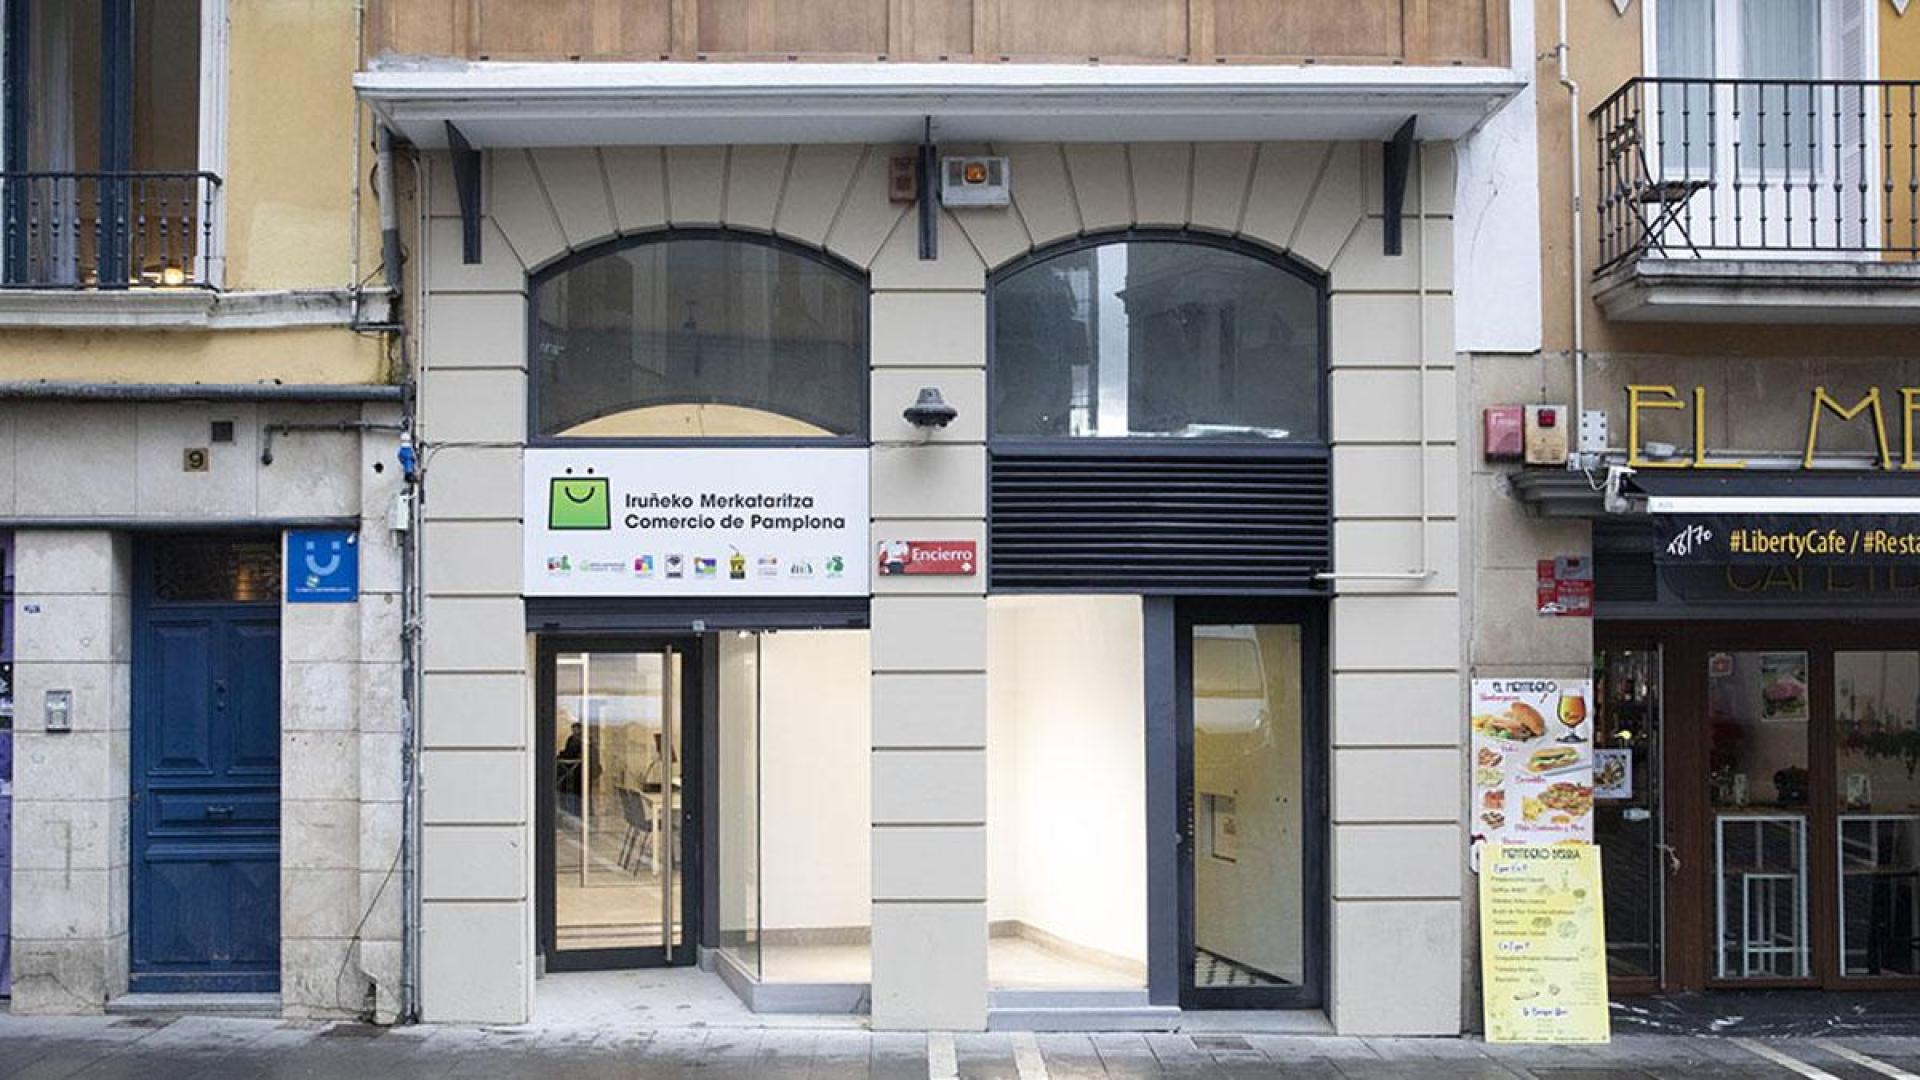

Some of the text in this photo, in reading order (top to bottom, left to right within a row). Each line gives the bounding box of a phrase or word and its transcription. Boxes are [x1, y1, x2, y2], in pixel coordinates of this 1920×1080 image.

[1627, 384, 1747, 468] EL
[189, 450, 204, 469] 9
[625, 492, 814, 508] Iruñeko Merkataritza
[624, 513, 845, 532] Comercio de Pamplona
[911, 546, 972, 561] Encierro
[1729, 529, 1846, 559] #LibertyCafe
